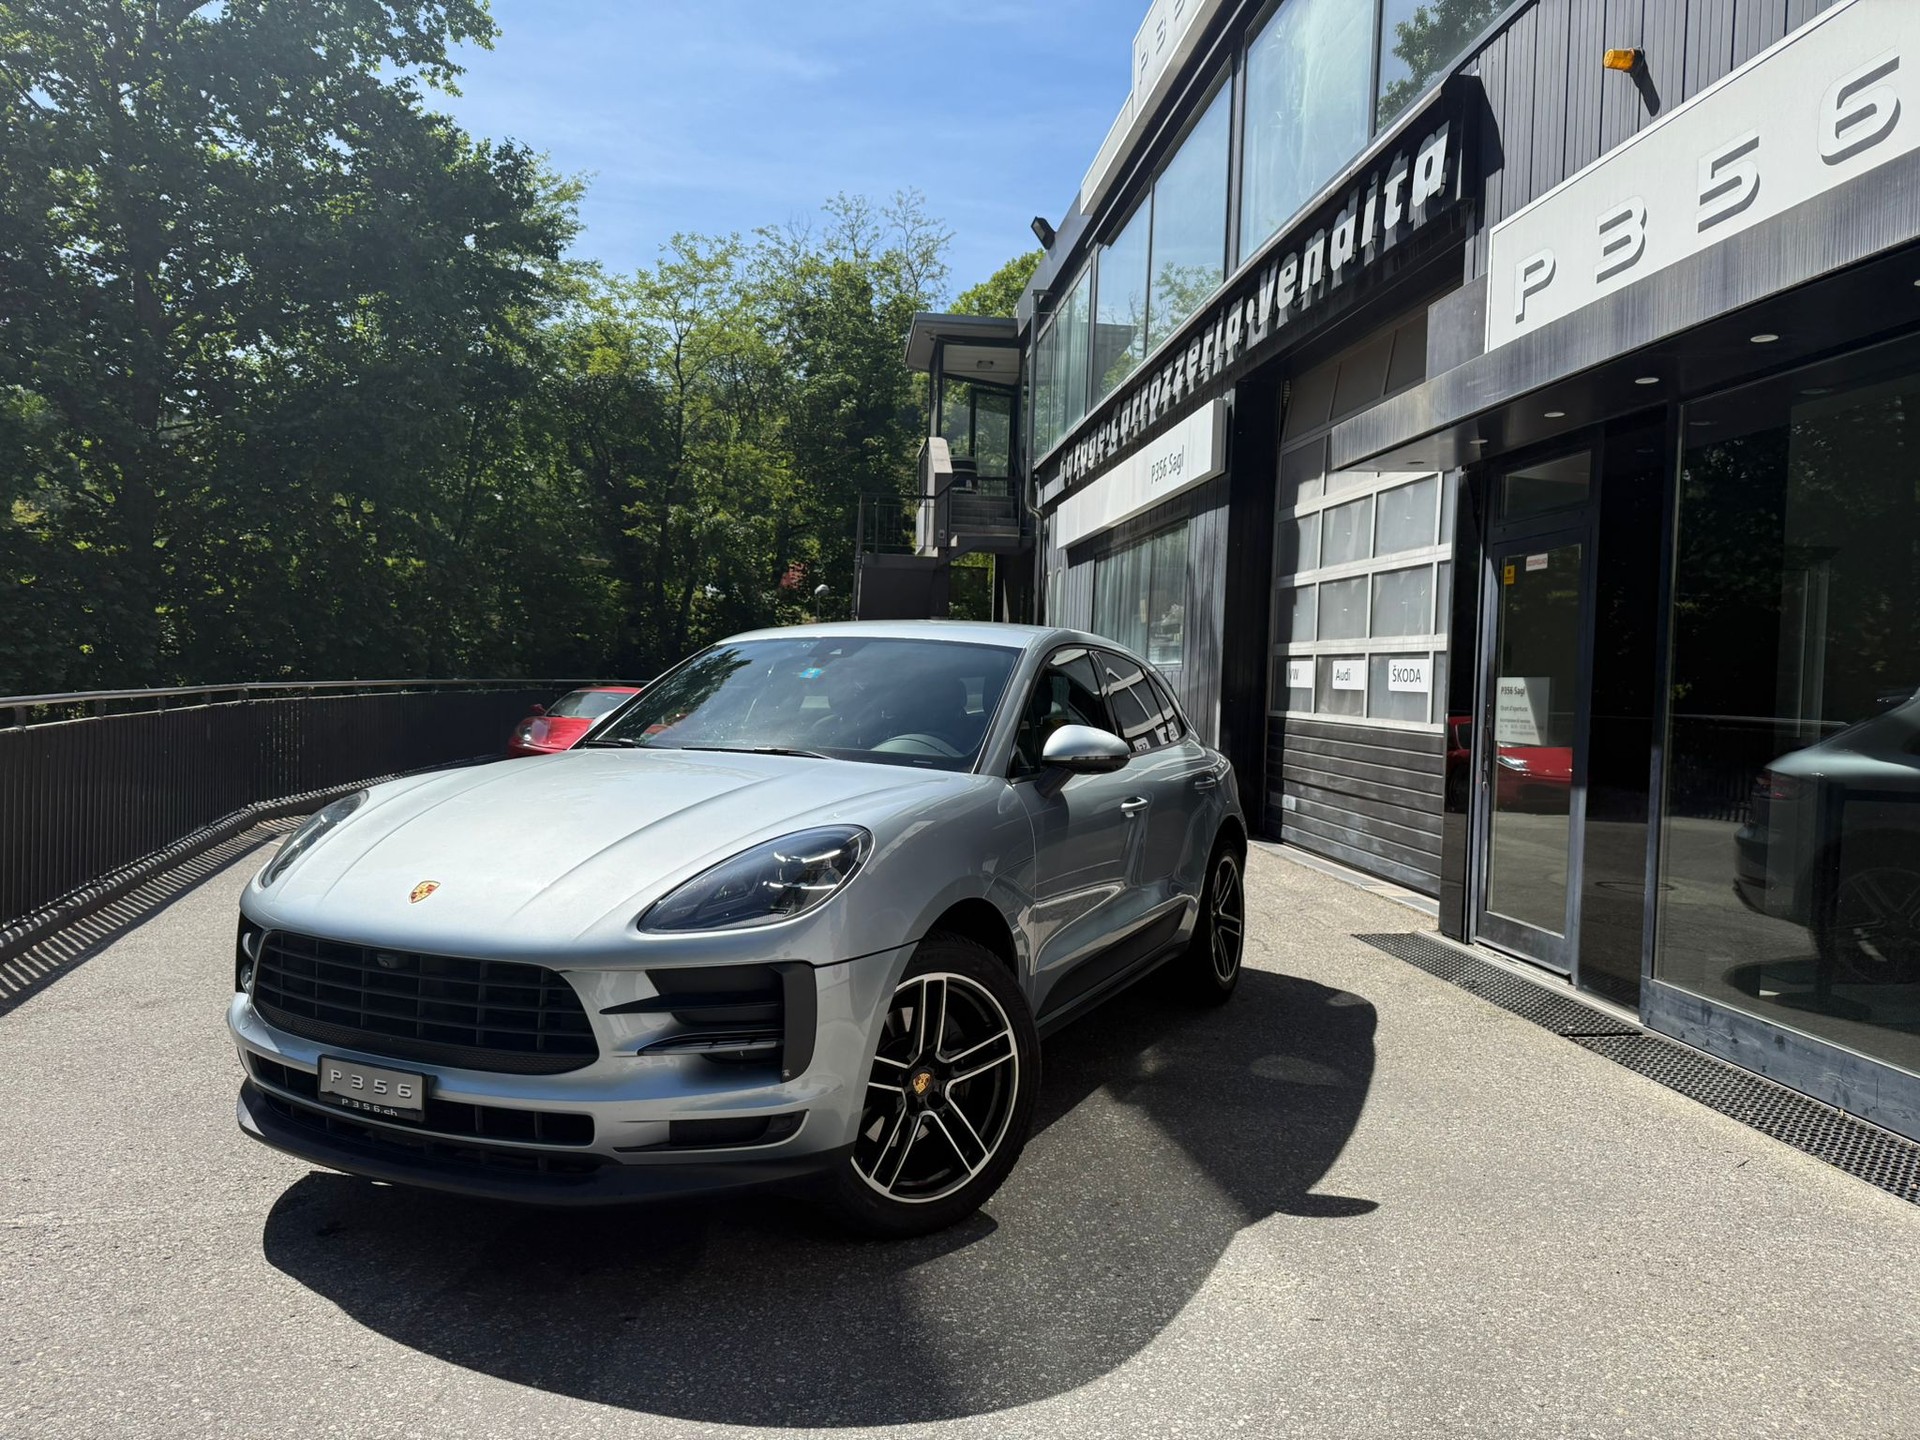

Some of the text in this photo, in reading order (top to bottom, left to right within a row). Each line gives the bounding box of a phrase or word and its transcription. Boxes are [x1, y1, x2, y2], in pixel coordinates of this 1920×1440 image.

[1515, 46, 1901, 325] P356
[1151, 457, 1168, 485] P356
[1335, 668, 1351, 681] Audi
[1392, 665, 1422, 683] ŠKODA
[330, 1069, 412, 1098] P356
